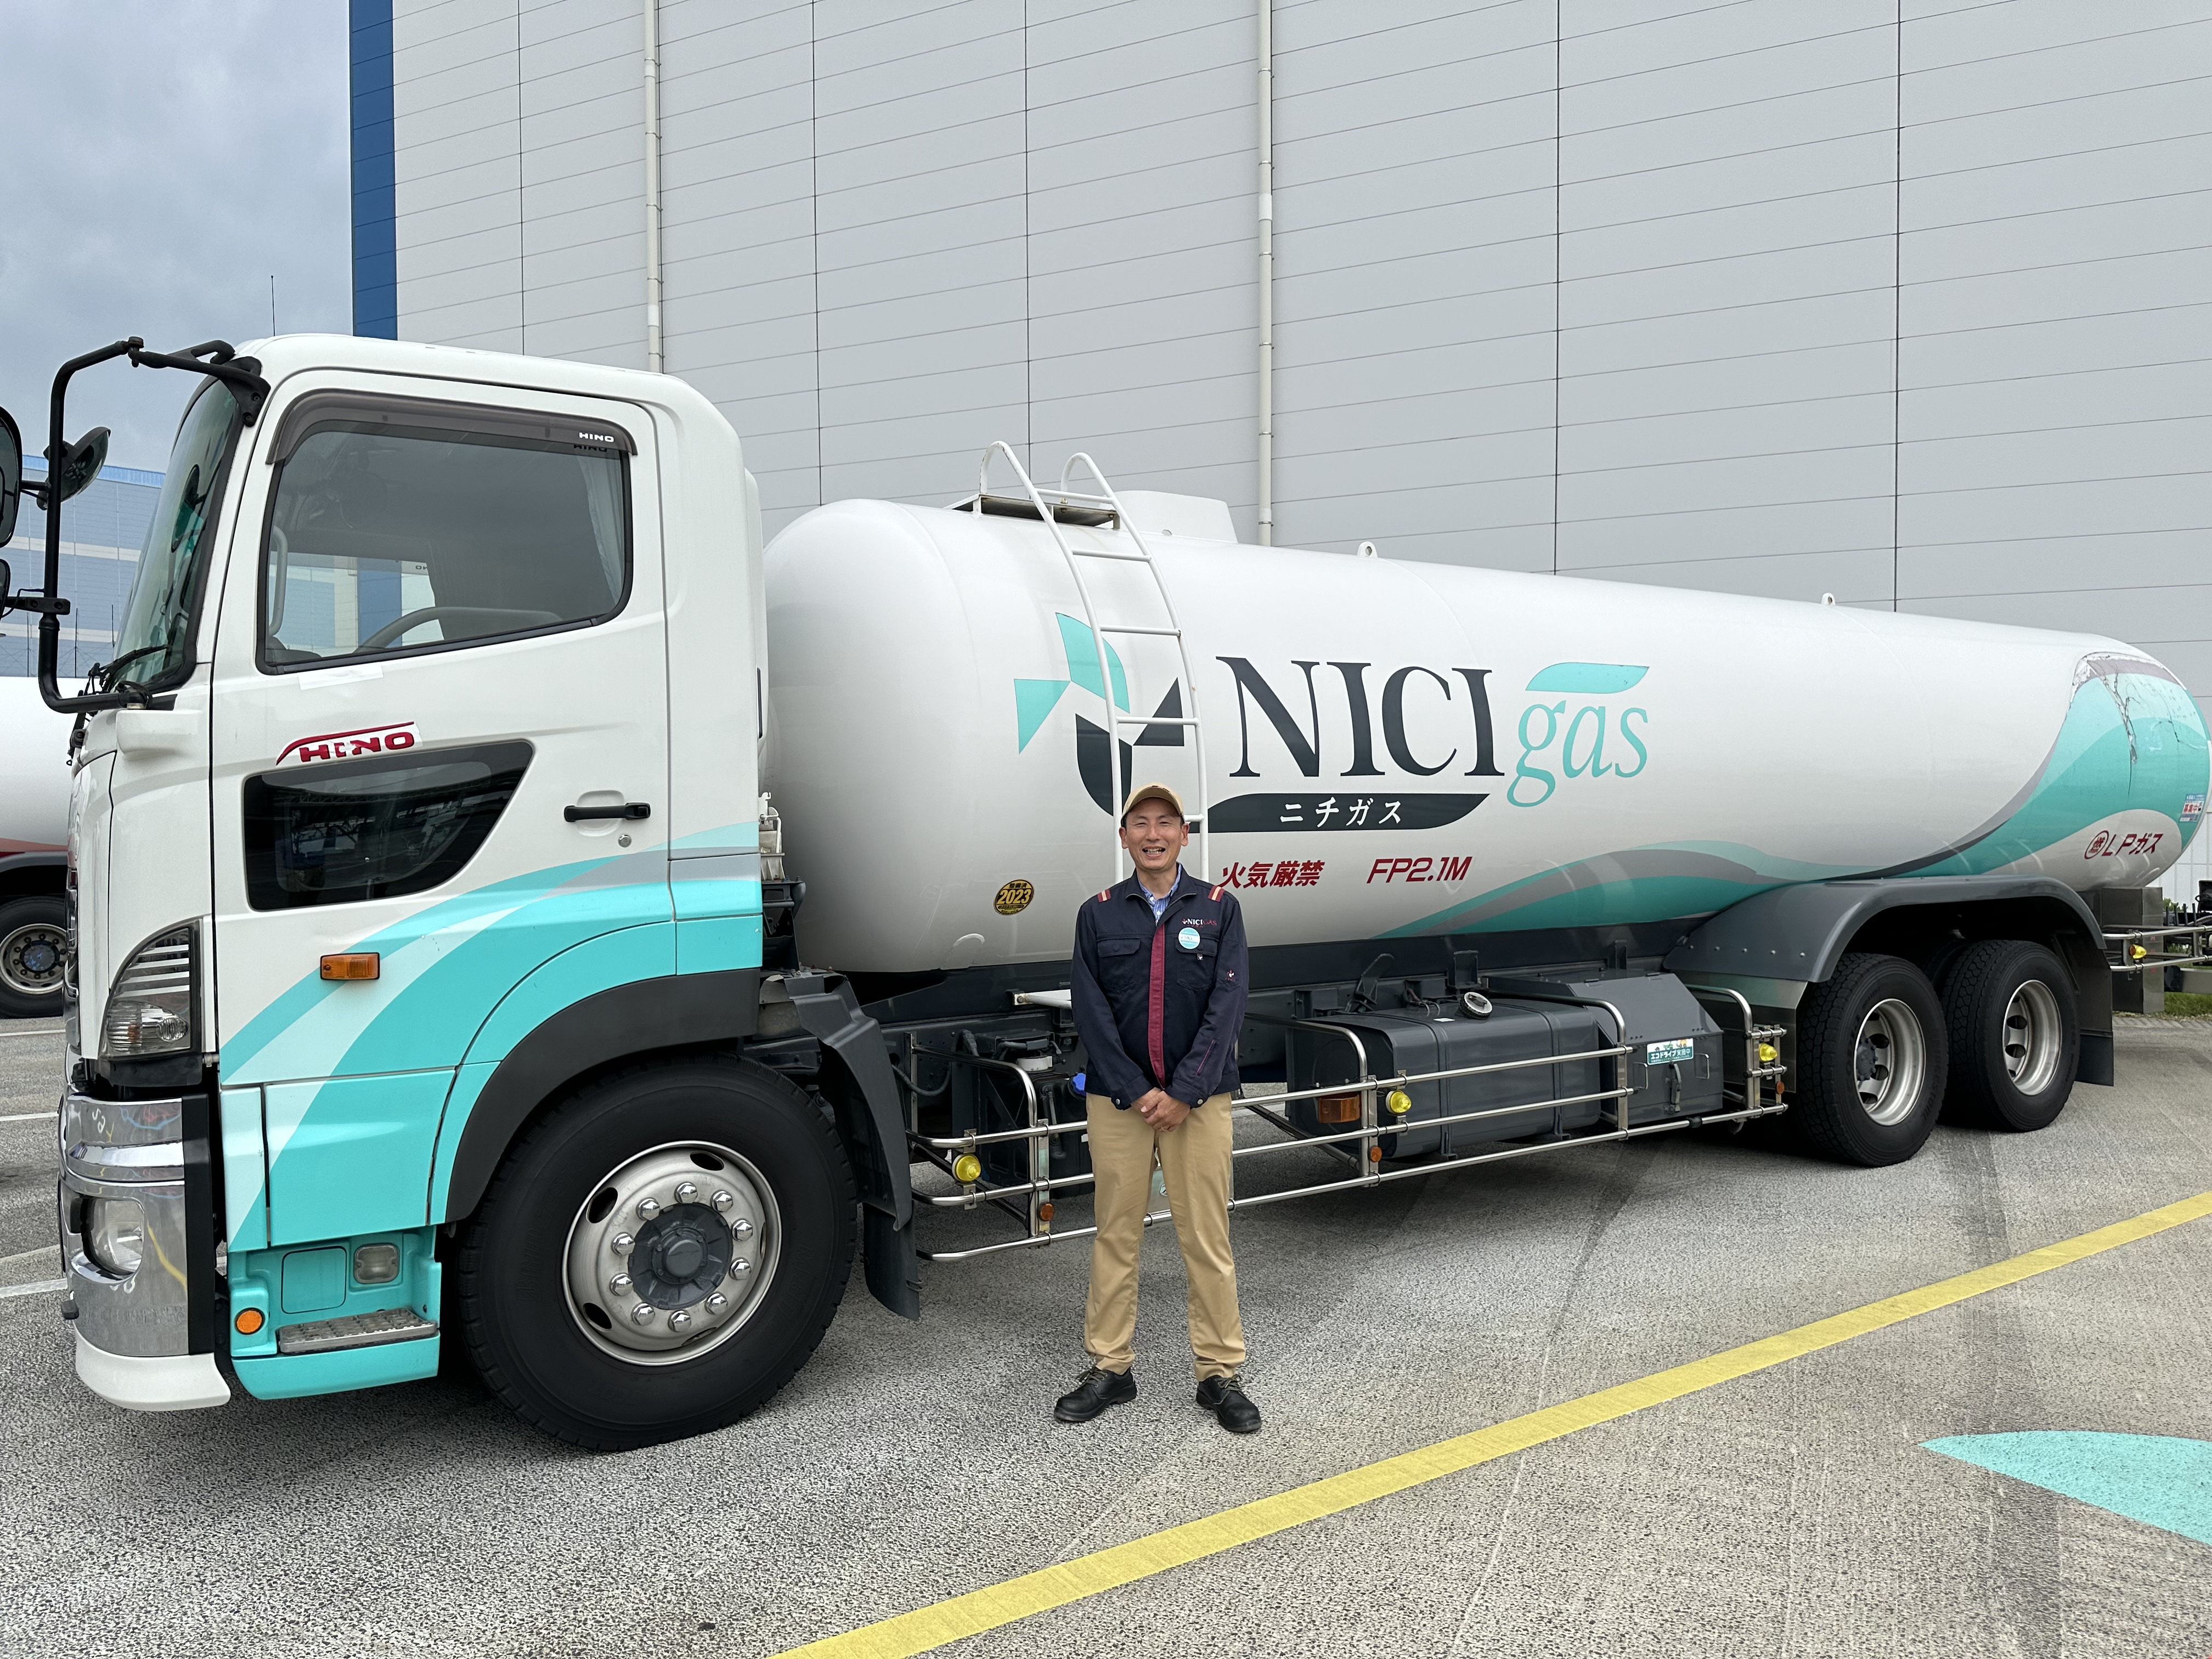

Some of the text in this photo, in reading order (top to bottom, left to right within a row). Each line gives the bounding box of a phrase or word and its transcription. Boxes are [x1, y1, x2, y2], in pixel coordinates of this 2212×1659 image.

[579, 432, 614, 442] HINO
[299, 731, 415, 763] HINO
[1215, 656, 1649, 808] NICI gas
[1279, 796, 1402, 828] ニチガス
[1216, 856, 1473, 889] 火気厳禁 FP2.1M
[997, 888, 1032, 904] 2023
